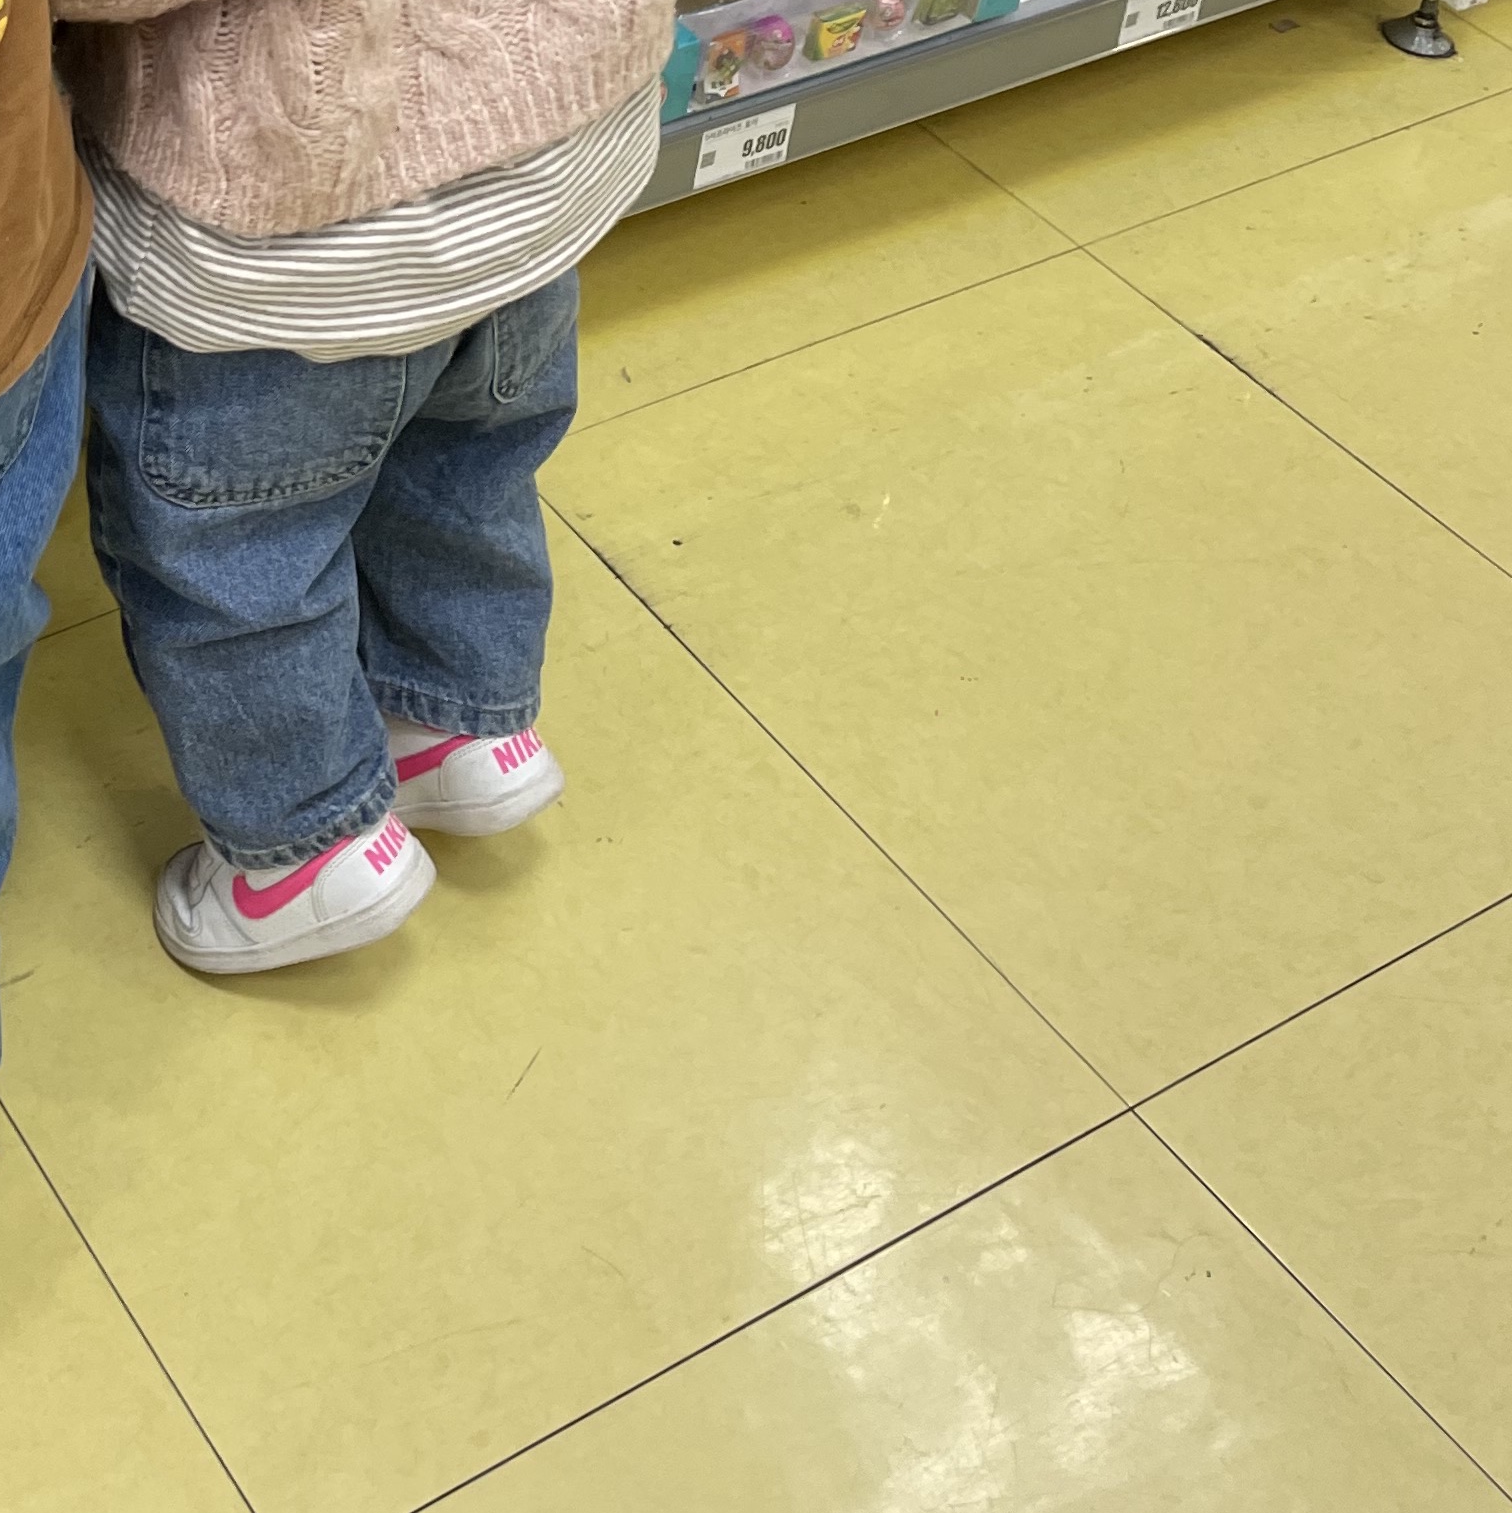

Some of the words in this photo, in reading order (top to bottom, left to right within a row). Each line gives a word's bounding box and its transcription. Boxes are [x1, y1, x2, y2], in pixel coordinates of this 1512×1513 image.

[742, 128, 788, 159] 9,800
[491, 726, 544, 775] NIK
[364, 812, 409, 876] NIK
